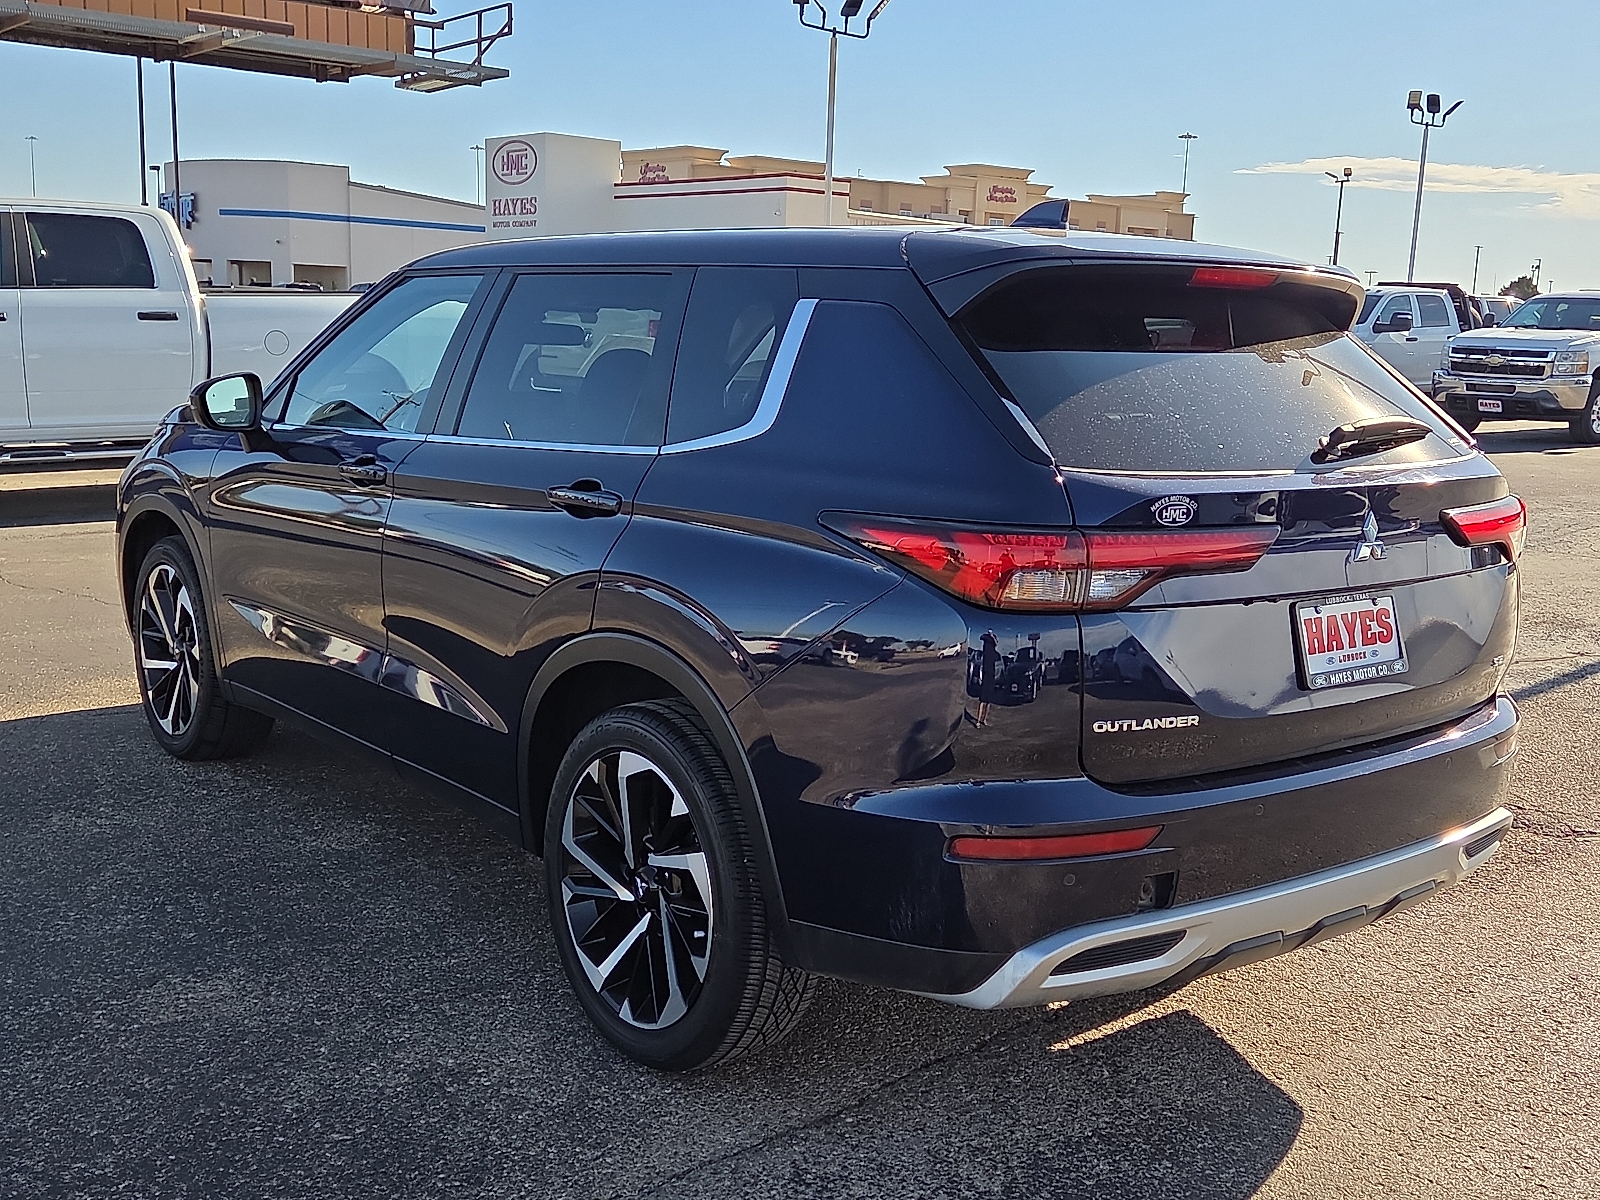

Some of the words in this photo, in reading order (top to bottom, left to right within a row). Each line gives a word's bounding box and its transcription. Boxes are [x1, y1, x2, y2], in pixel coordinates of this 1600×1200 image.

[492, 197, 537, 216] HAYES
[493, 220, 511, 228] MOTOR
[512, 219, 537, 228] COMPANY
[1150, 496, 1170, 512] HAYES
[1170, 495, 1190, 503] MOTOR
[1162, 506, 1187, 522] HMC
[1353, 593, 1369, 601] TEXAS
[1303, 607, 1394, 655] HAYES
[1338, 650, 1367, 663] LUBBOCK
[1329, 671, 1352, 685] HAYES
[1352, 668, 1377, 680] MOTOR
[1378, 665, 1390, 676] CO.
[1092, 715, 1200, 733] OUTLANDER
